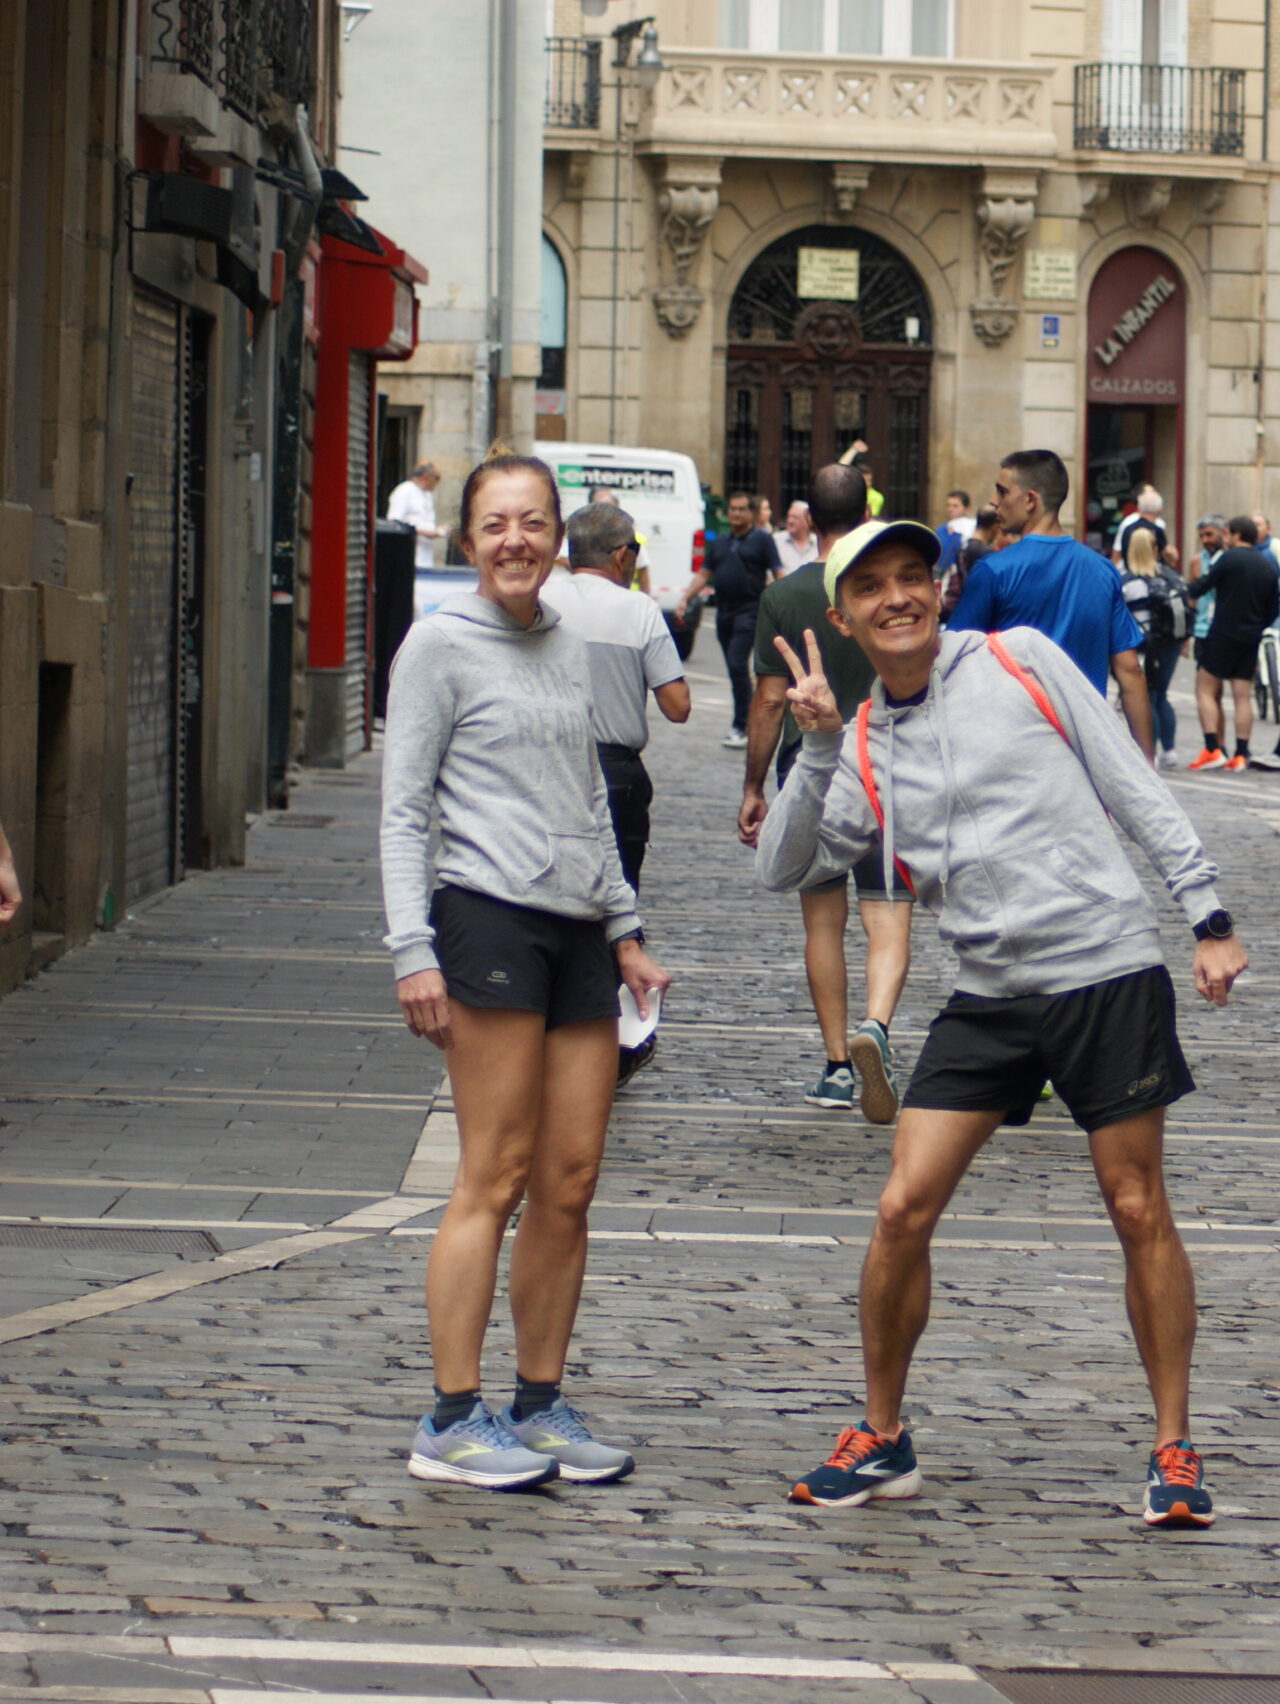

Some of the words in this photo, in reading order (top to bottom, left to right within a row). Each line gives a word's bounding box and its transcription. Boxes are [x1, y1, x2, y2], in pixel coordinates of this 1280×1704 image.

[1094, 337, 1124, 365] LA
[1113, 275, 1177, 343] INFANTIL
[1090, 377, 1178, 396] CALZADOS
[558, 467, 675, 491] enterprise
